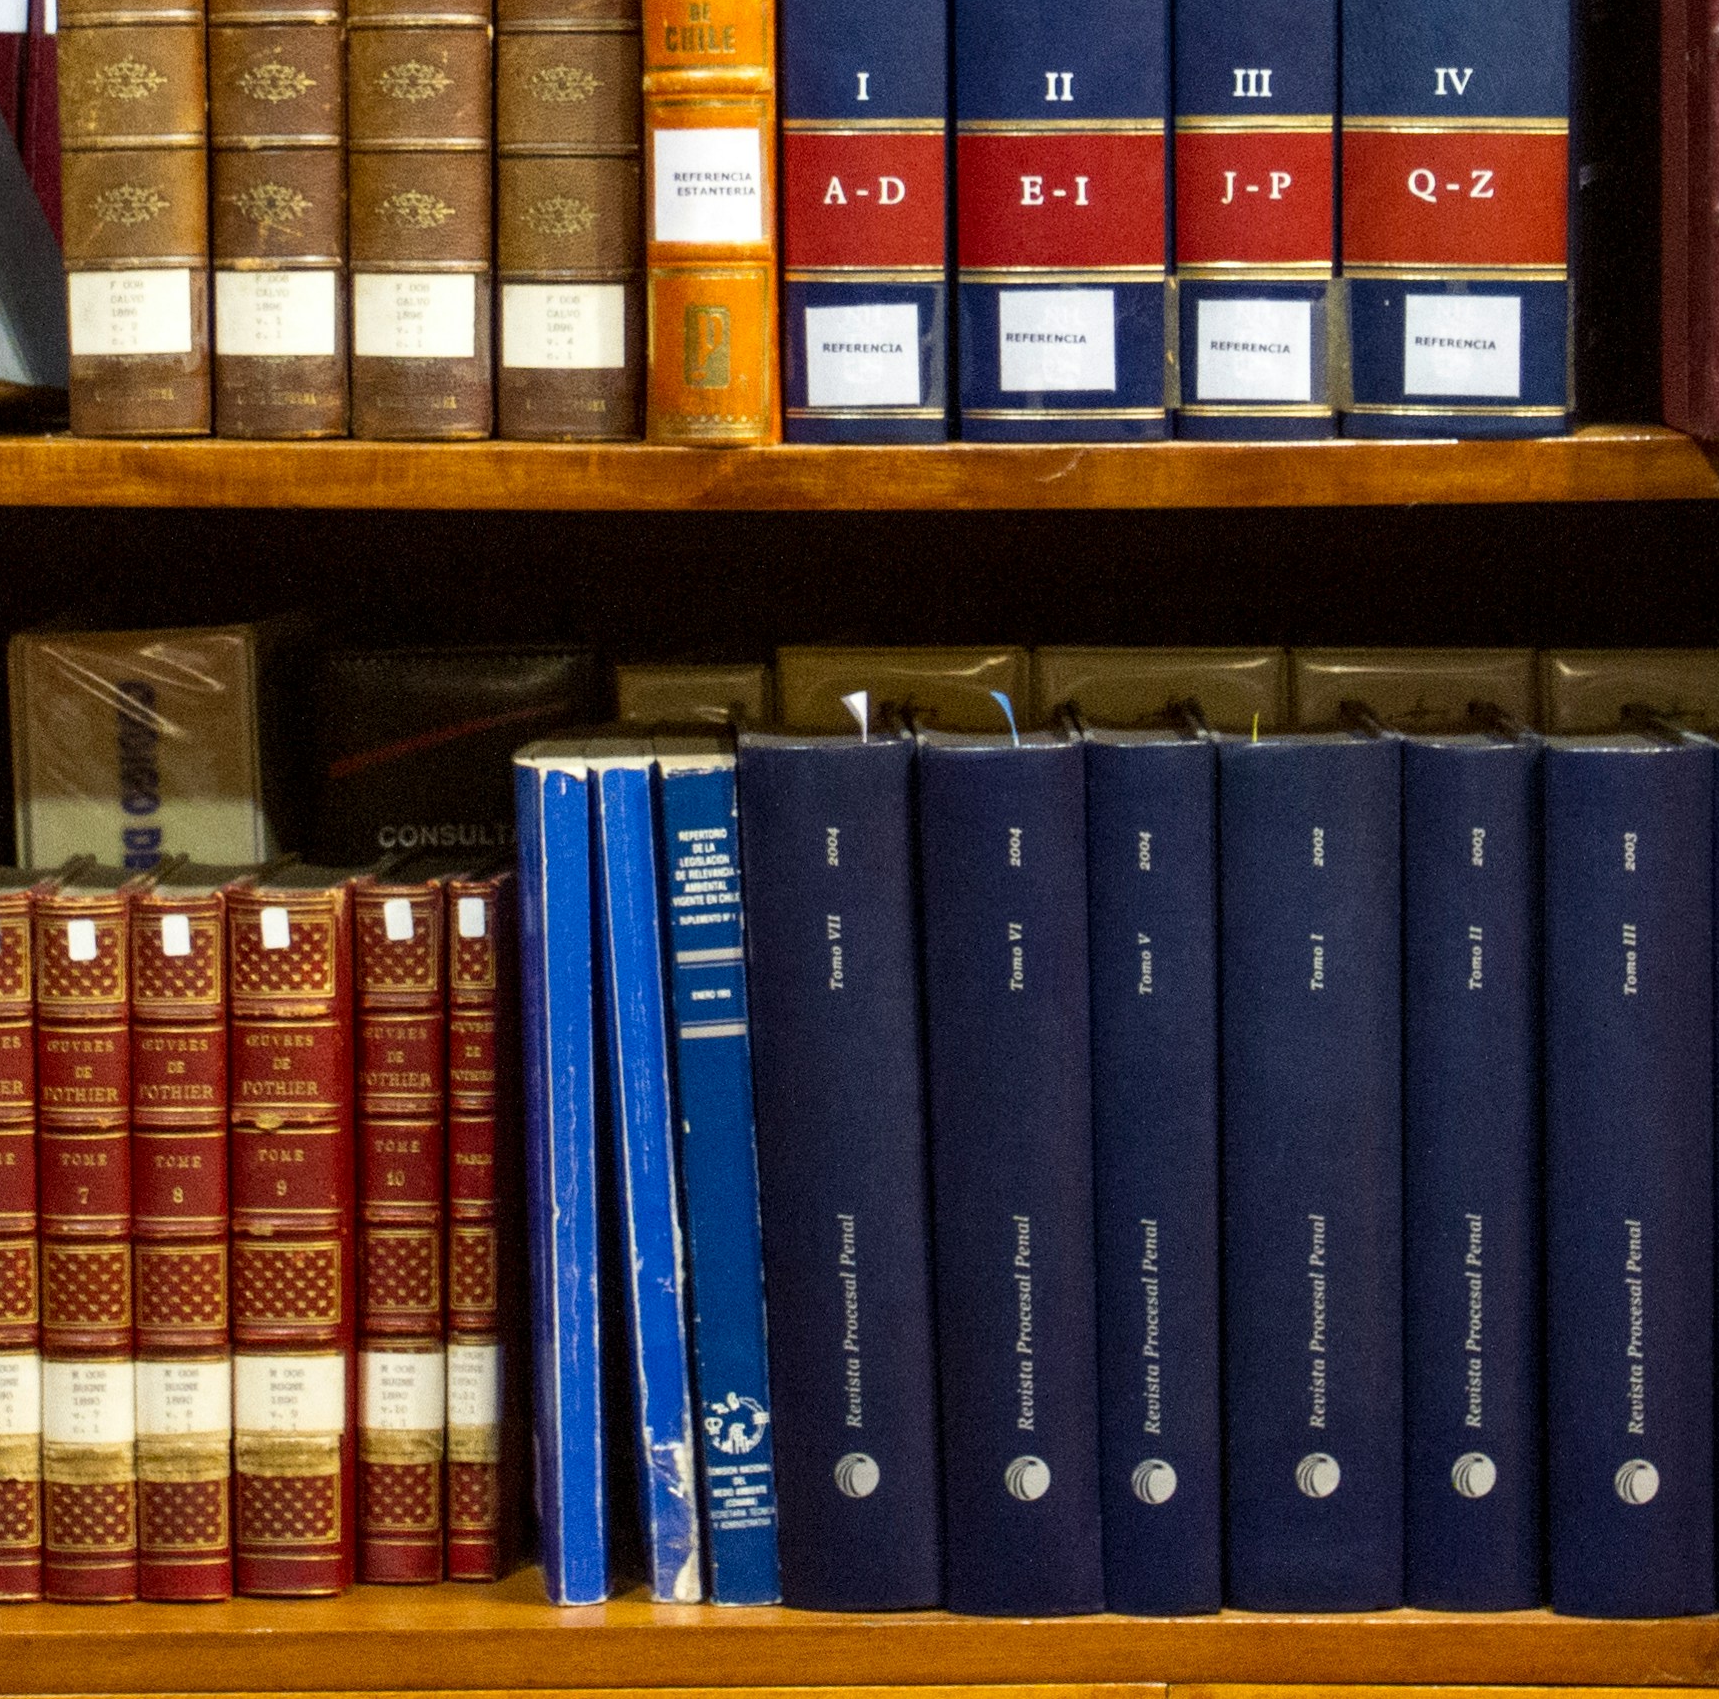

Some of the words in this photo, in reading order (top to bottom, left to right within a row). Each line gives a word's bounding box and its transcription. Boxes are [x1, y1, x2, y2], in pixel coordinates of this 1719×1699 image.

[857, 73, 869, 101] I
[1045, 73, 1074, 101] II
[1233, 69, 1272, 97] III
[1435, 68, 1473, 95] IV
[673, 172, 752, 183] REFERENCIA
[677, 186, 756, 197] ESTANTERIA
[824, 177, 847, 205] A
[879, 177, 906, 205] D
[1021, 177, 1044, 205] E
[1075, 177, 1088, 205] I
[1221, 172, 1237, 204] J
[1269, 172, 1292, 199] P
[1408, 169, 1437, 203] Q
[1470, 171, 1494, 198] Z
[822, 342, 903, 354] REFERENCIA
[1005, 333, 1087, 344] REFERENCIA
[1211, 341, 1291, 354] REFERENCIA
[1415, 336, 1497, 351] REFERENCIA
[826, 827, 840, 867] 2004
[1009, 827, 1023, 867] 2004
[1138, 831, 1153, 871] 2004
[1312, 827, 1326, 867] 2002
[1472, 827, 1486, 866] 2003
[1624, 832, 1638, 871] 2003
[828, 915, 842, 941] VII
[1009, 922, 1022, 943] VI
[1138, 933, 1152, 946] V
[1311, 934, 1324, 942] I
[1470, 926, 1483, 942] II
[1623, 924, 1637, 946] III
[830, 945, 844, 990] Tomo
[1010, 947, 1024, 991] Tomo
[1139, 949, 1153, 995] Tomo
[1311, 947, 1324, 991] Tomo
[1469, 945, 1483, 990] Tomo
[1624, 950, 1637, 995] Tomo
[837, 1213, 856, 1267] Penal
[1464, 1213, 1483, 1267] Penal
[840, 1271, 859, 1352] Procesal
[1465, 1271, 1482, 1352] Procesal
[845, 1358, 863, 1429] Revista
[1466, 1358, 1483, 1429] Revista
